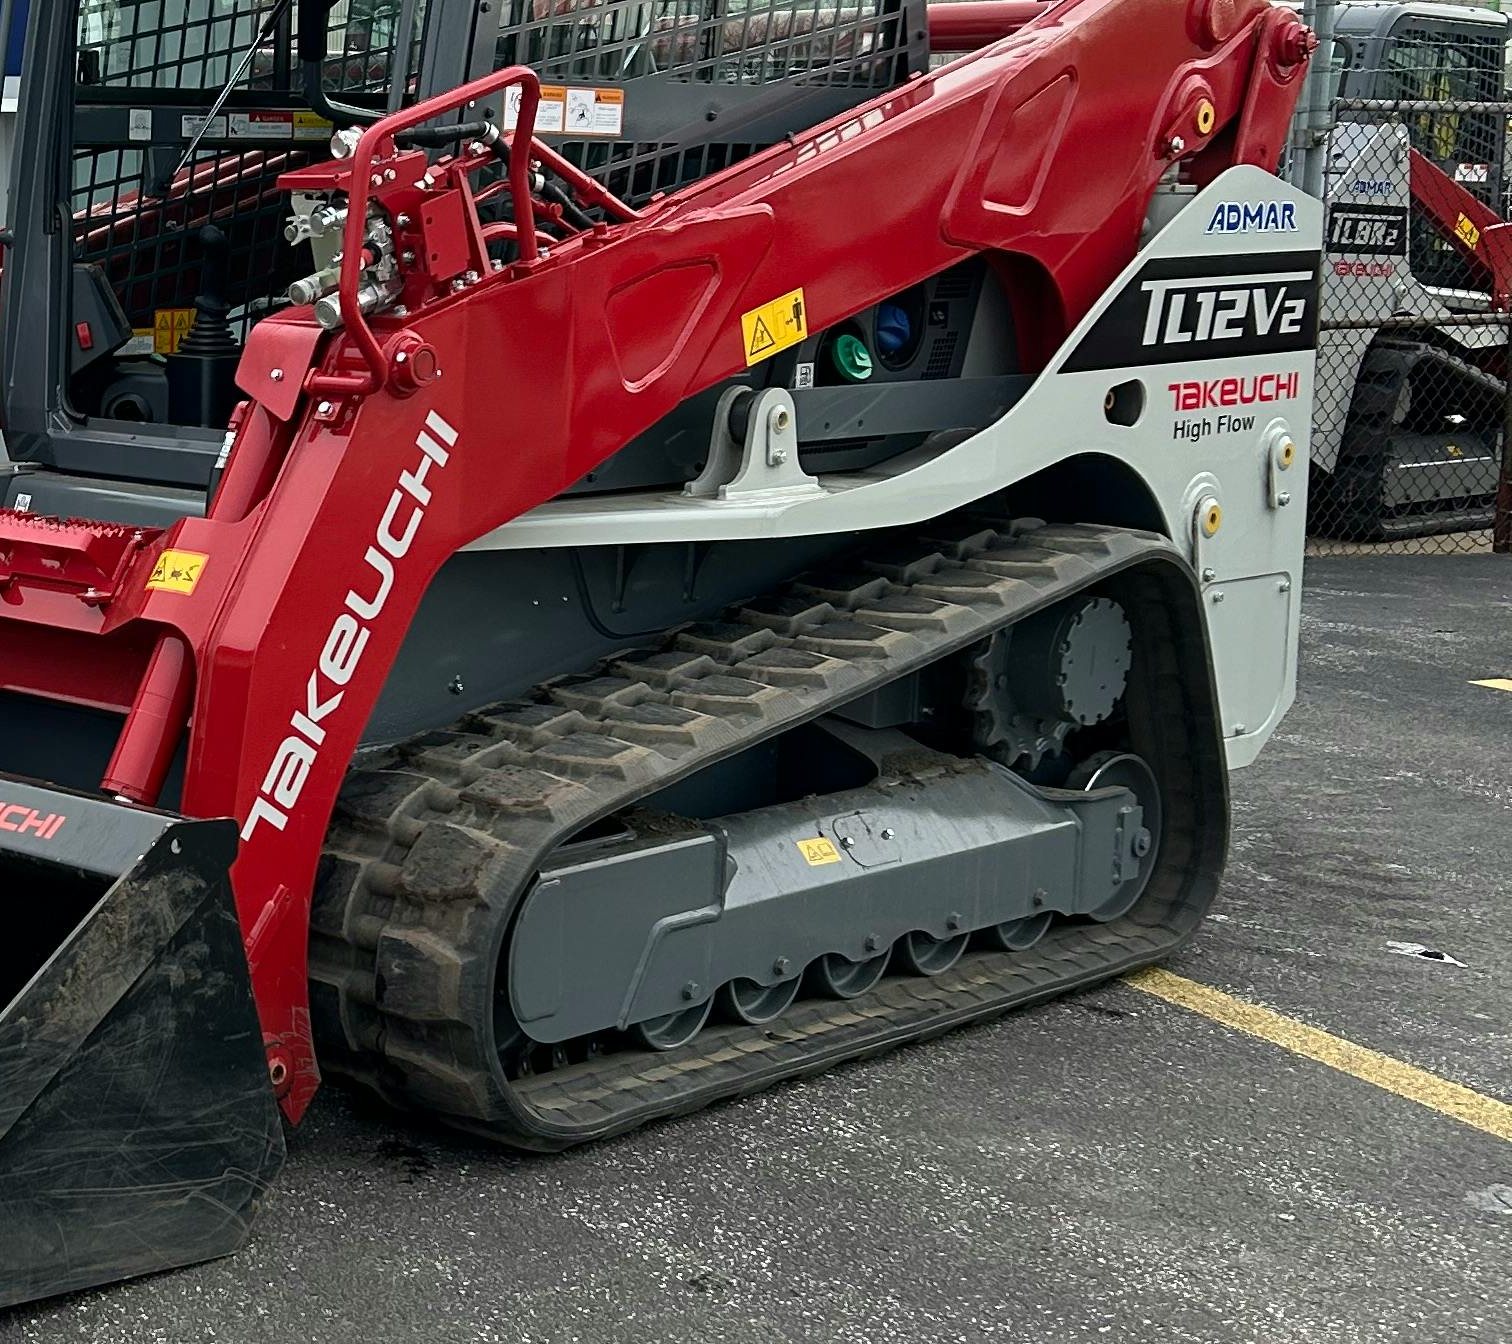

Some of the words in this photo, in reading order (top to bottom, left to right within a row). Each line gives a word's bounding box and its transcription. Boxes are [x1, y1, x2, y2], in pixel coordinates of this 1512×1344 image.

[1207, 203, 1297, 233] ADMAR
[1140, 270, 1314, 346] TL12V2
[1173, 419, 1211, 443] High
[1216, 415, 1256, 434] Flow
